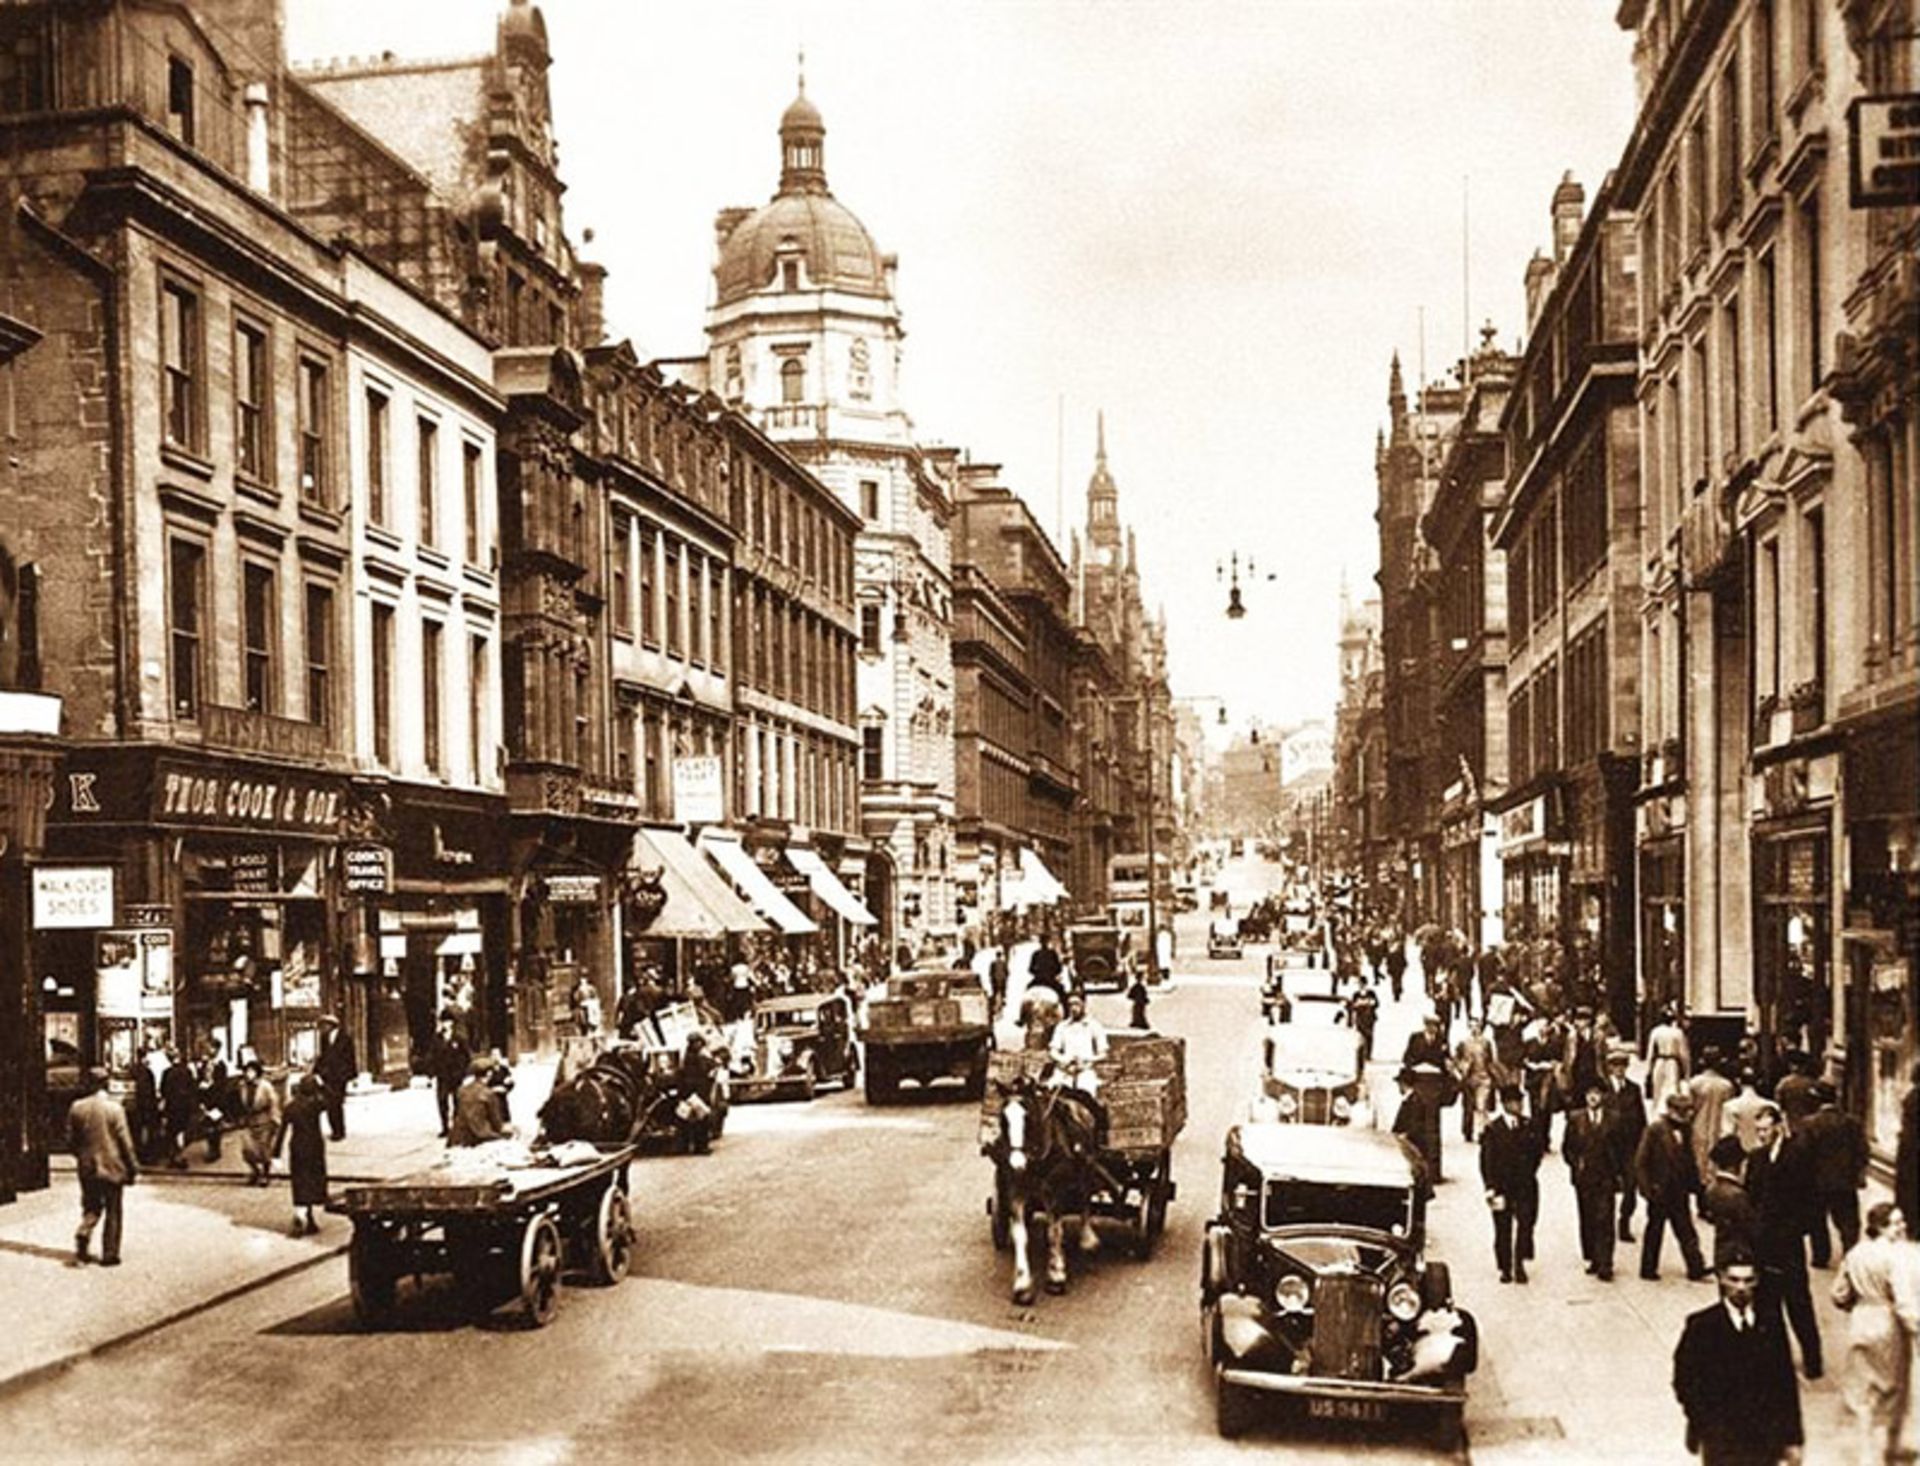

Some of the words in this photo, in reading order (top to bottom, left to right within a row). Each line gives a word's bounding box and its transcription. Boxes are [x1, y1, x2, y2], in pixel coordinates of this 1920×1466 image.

[226, 780, 277, 819] COOK
[283, 788, 296, 822] &
[347, 879, 384, 891] OFFICE
[48, 898, 99, 915] SHOES
